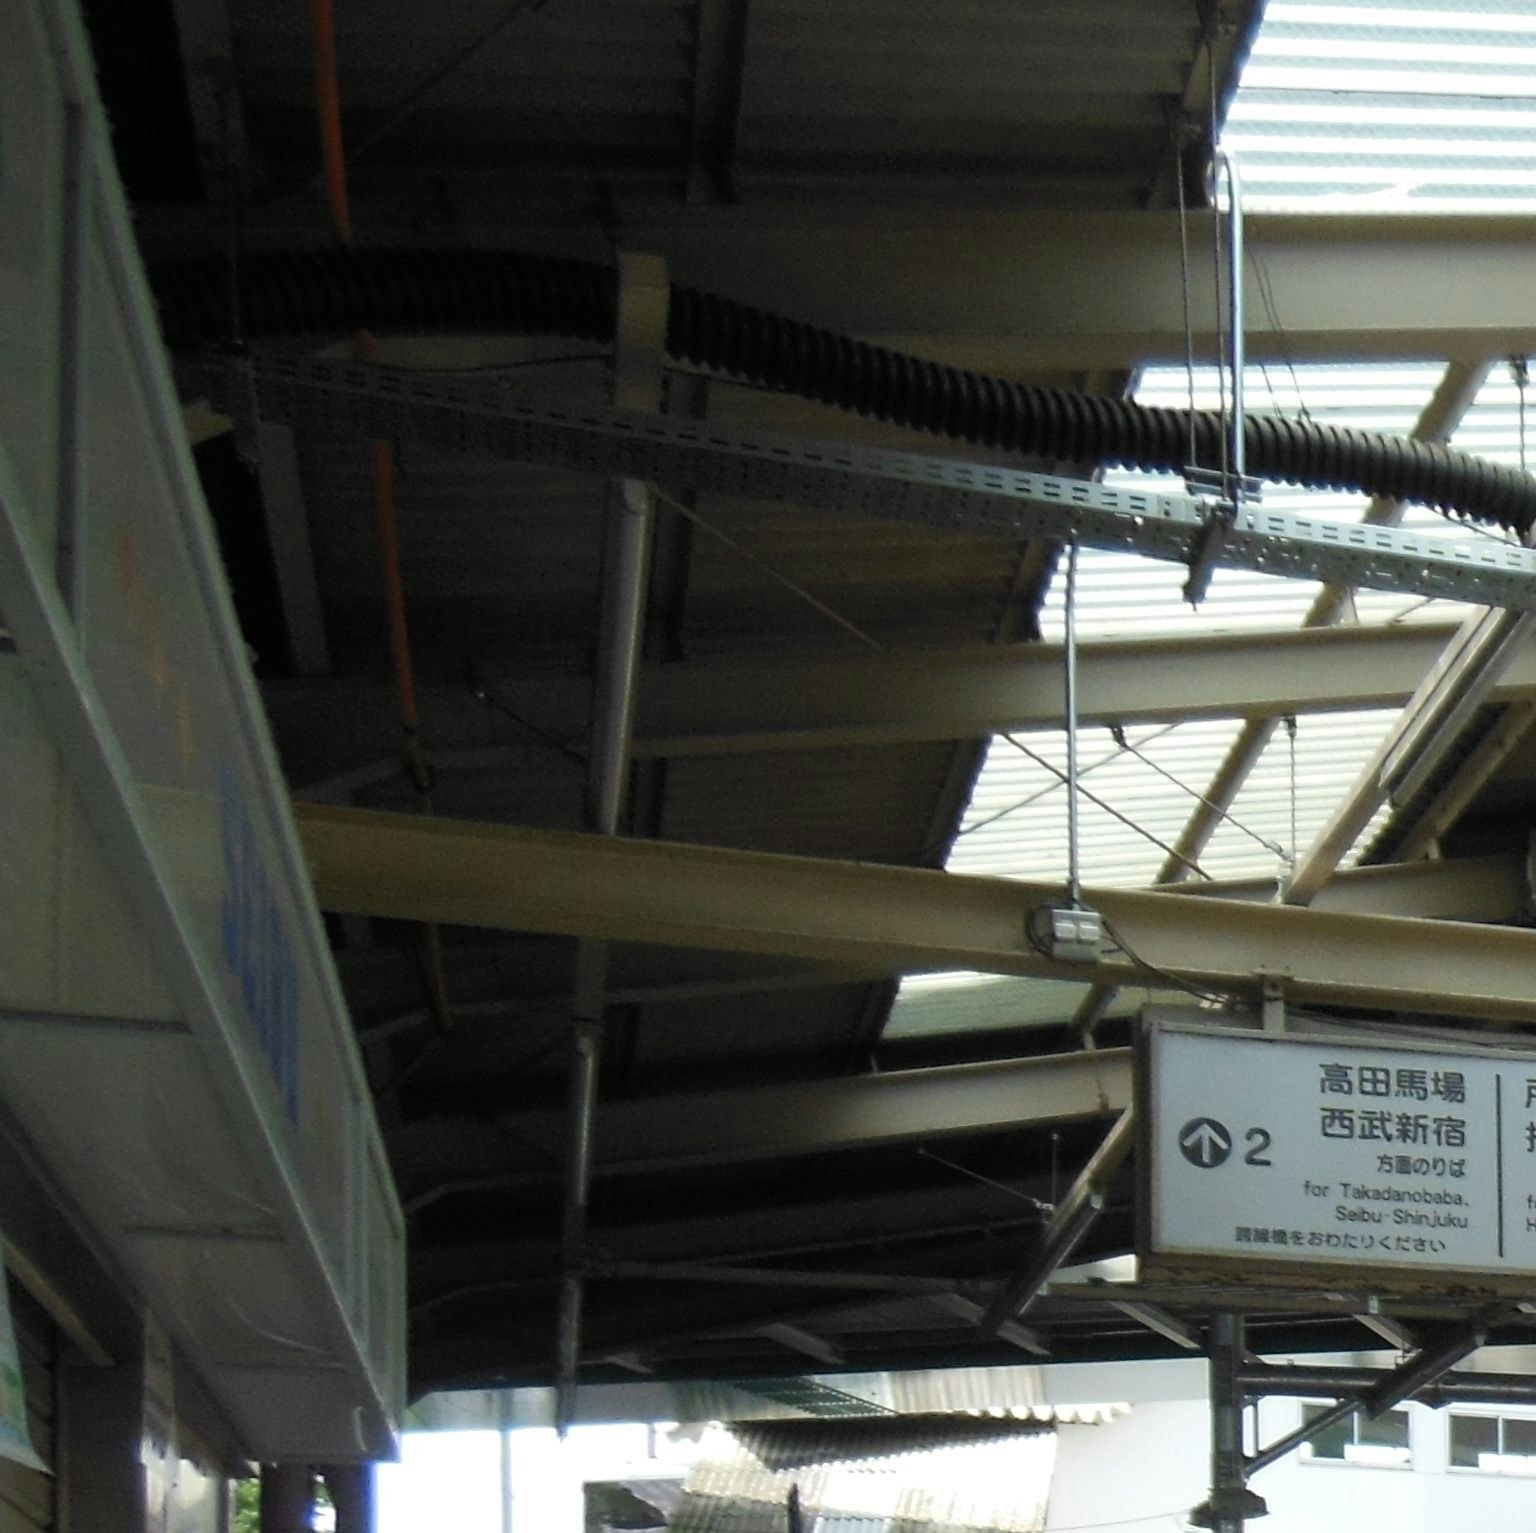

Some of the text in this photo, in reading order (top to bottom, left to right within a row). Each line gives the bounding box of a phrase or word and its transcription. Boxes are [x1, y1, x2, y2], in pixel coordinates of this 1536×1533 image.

[1319, 1063, 1466, 1103] 高田馬場
[1244, 1127, 1272, 1166] 2
[1320, 1107, 1466, 1147] 西武新宿
[1377, 1154, 1466, 1178] 方面のりば
[1304, 1180, 1330, 1198] for
